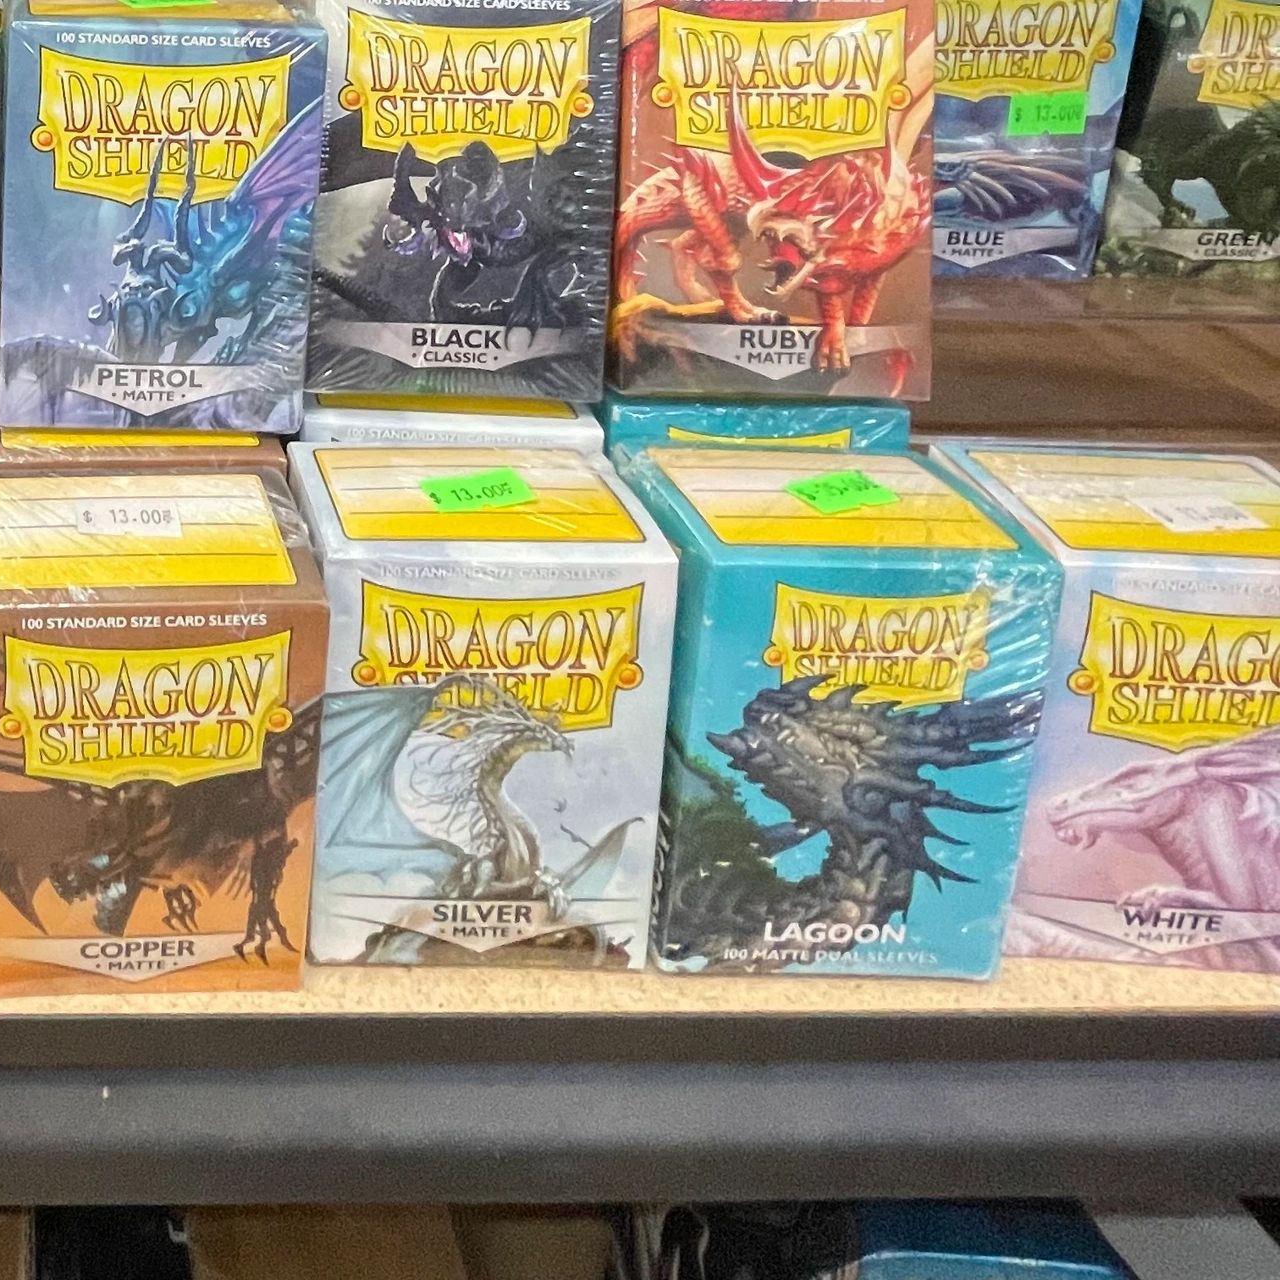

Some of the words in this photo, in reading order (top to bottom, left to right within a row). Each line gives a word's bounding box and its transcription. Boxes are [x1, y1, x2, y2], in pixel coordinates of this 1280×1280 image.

[520, 0, 571, 11] SLEEVES
[56, 32, 75, 44] 100
[78, 32, 148, 45] STANDARD
[151, 34, 178, 45] SIZE
[181, 34, 217, 47] CARD
[219, 34, 271, 49] SLEEVES
[365, 31, 577, 98] DRAGON
[674, 27, 892, 91] DRAGON
[934, 49, 1086, 84] SHIELD
[56, 69, 277, 137] DRAGON
[687, 90, 879, 136] SHIELD
[375, 95, 561, 142] SHIELD
[68, 135, 257, 181] SHIELD
[946, 230, 1006, 246] BLUE
[951, 247, 994, 258] MATTE
[1204, 248, 1258, 258] CLASSIC
[410, 327, 503, 350] BLACK
[739, 328, 818, 350] RUBY
[423, 351, 488, 364] CLASSIC
[747, 351, 807, 366] MATTE
[97, 367, 202, 388] PETROL
[122, 390, 175, 403] MATTE
[428, 491, 442, 505] $
[82, 510, 93, 524] $
[21, 616, 44, 630] 100
[46, 615, 127, 629] STANDARD
[130, 615, 162, 628] SIZE
[164, 614, 206, 628] CARD
[208, 613, 268, 627] SLEEVES
[790, 601, 980, 656] DRAGON
[381, 604, 626, 671] DRAGON
[794, 654, 959, 692] SHIELD
[23, 652, 275, 720] DRAGON
[39, 718, 255, 765] SHIELD
[432, 904, 533, 924] SILVER
[1124, 909, 1224, 933] WHITE
[452, 925, 510, 939] MATTE
[762, 921, 908, 945] LAGOON
[1137, 931, 1197, 944] MATTE
[80, 939, 197, 960] COPPER
[723, 947, 748, 962] 100
[752, 948, 810, 963] MATTE
[814, 949, 866, 964] DUAL
[867, 949, 938, 965] SLEEVES
[107, 959, 167, 972] MATTE
